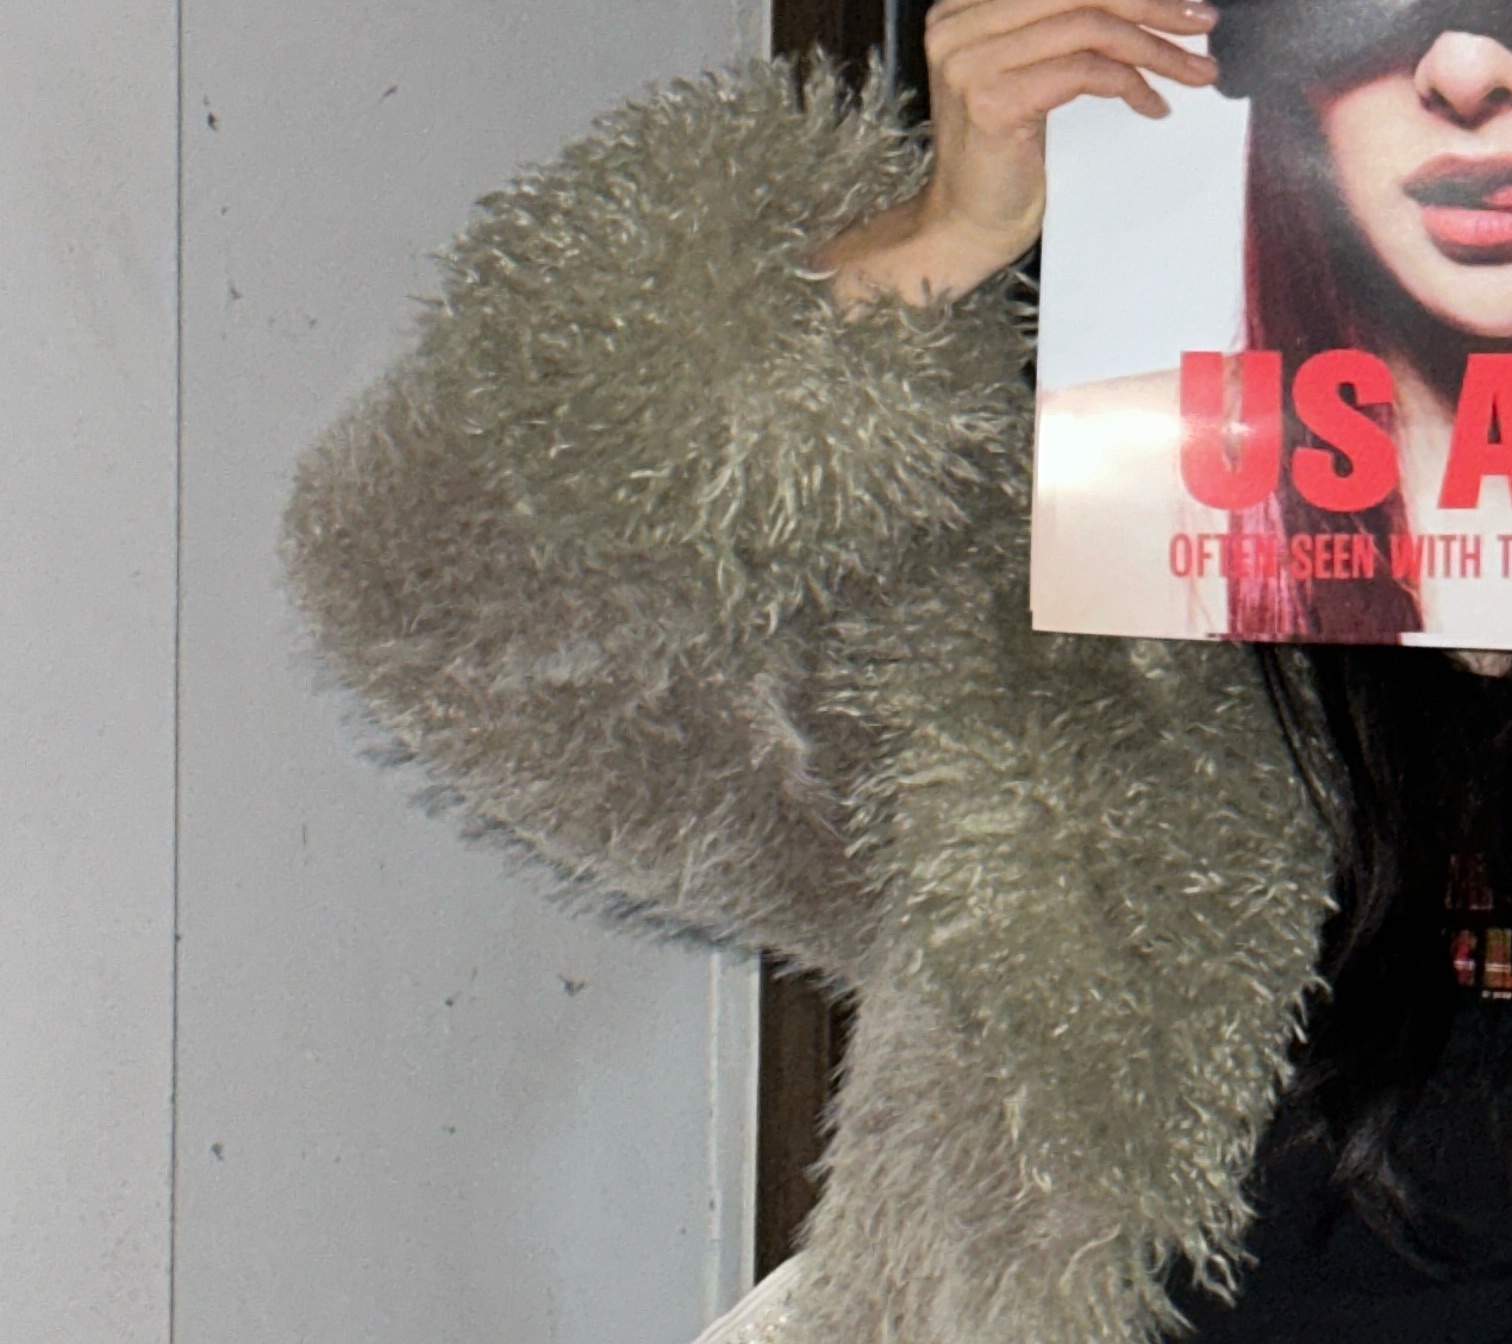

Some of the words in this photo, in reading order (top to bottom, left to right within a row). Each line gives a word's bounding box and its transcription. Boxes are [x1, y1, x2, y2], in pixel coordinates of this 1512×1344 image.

[1179, 351, 1400, 512] US
[1169, 532, 1278, 579] OFTEN
[1290, 534, 1374, 579] SEEN
[1391, 534, 1481, 579] WITH
